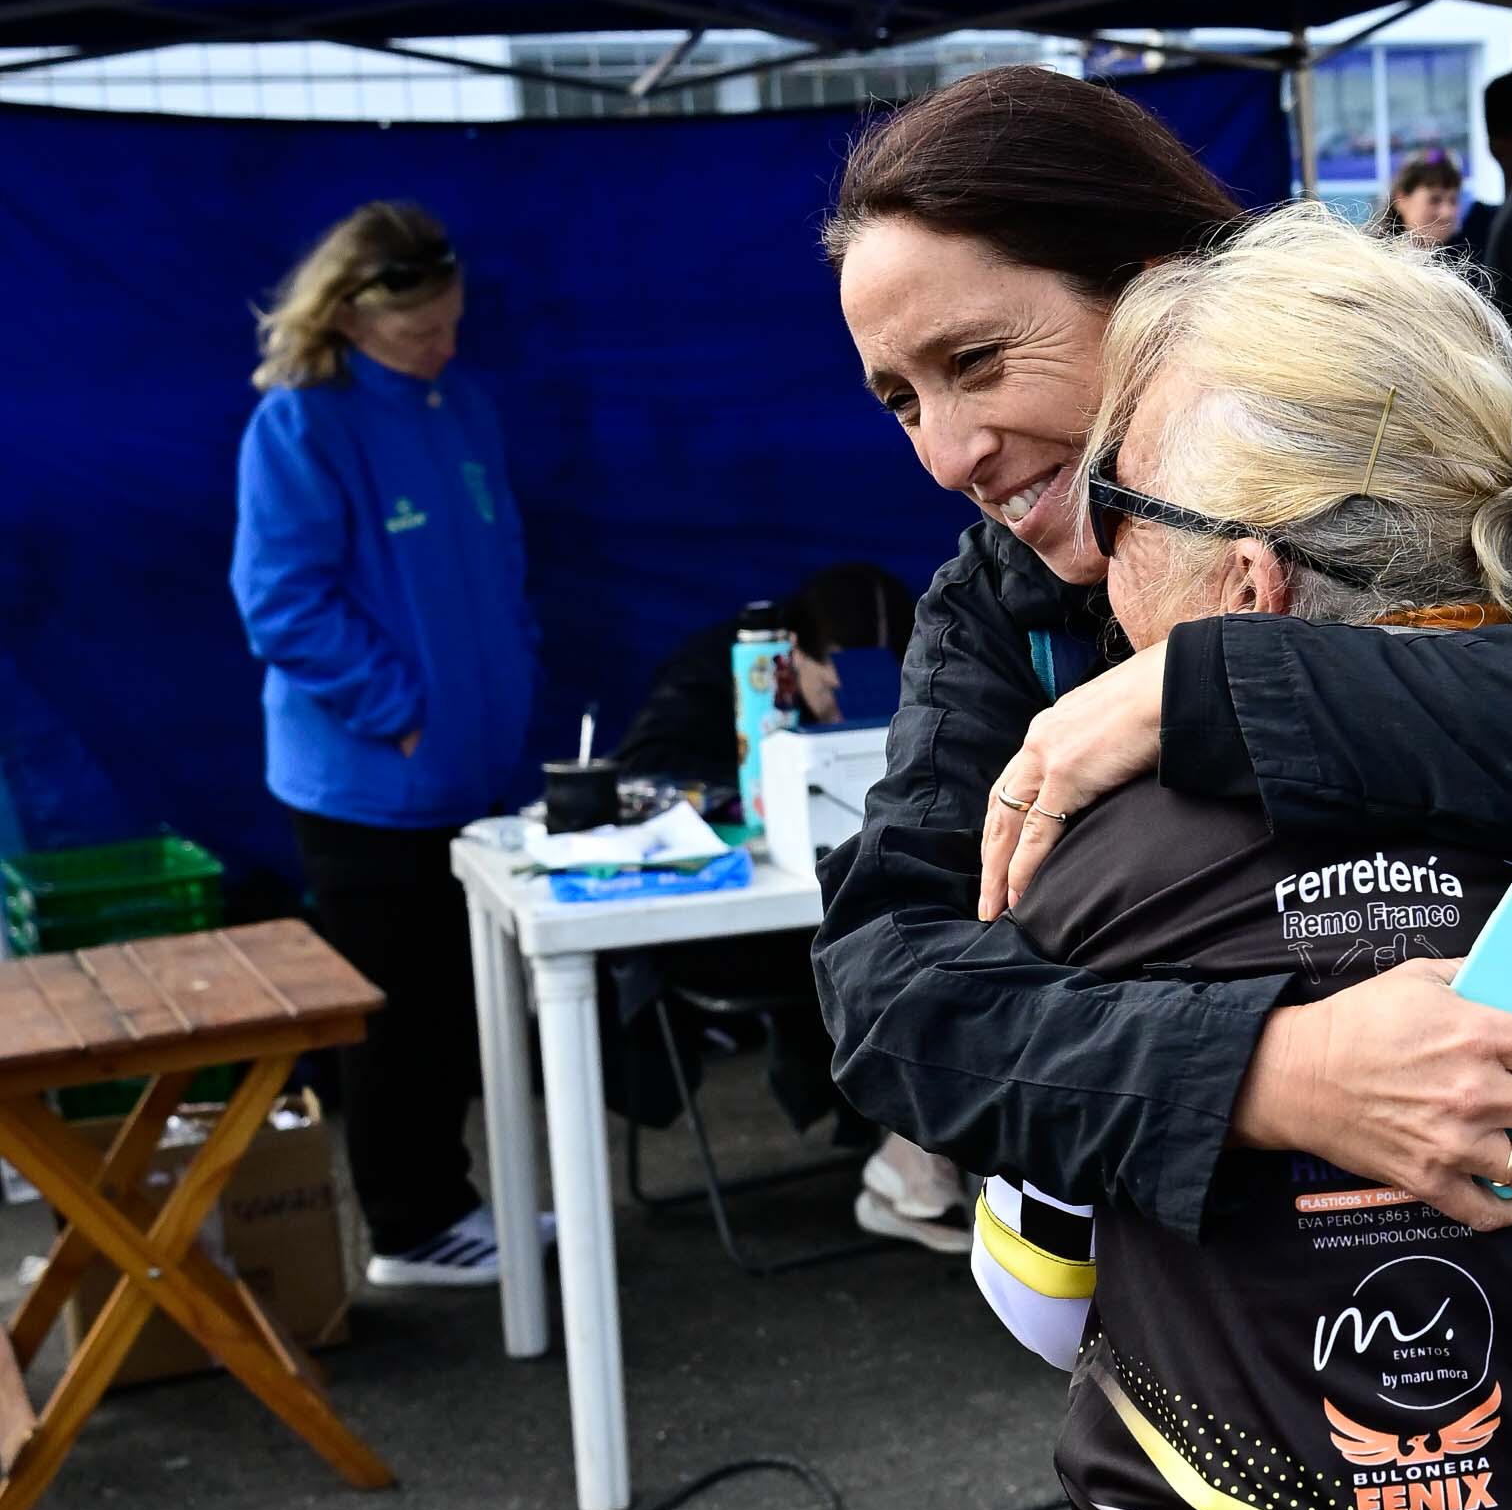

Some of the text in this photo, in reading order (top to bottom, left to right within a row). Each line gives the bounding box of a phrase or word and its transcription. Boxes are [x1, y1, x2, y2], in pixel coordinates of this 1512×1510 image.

[1275, 852, 1463, 912] Ferretería
[1283, 902, 1460, 939] Remo Franco
[1365, 1194, 1373, 1203] Y
[1298, 1217, 1323, 1230] EVA
[1327, 1213, 1374, 1226] PERÓN
[1378, 1210, 1410, 1225] 5863
[1313, 1226, 1473, 1249] WWW.HIDROLONG.COM
[1393, 1347, 1450, 1360] EVENTOS
[1382, 1368, 1468, 1389] by maru mora
[1353, 1457, 1490, 1485] BULONERA
